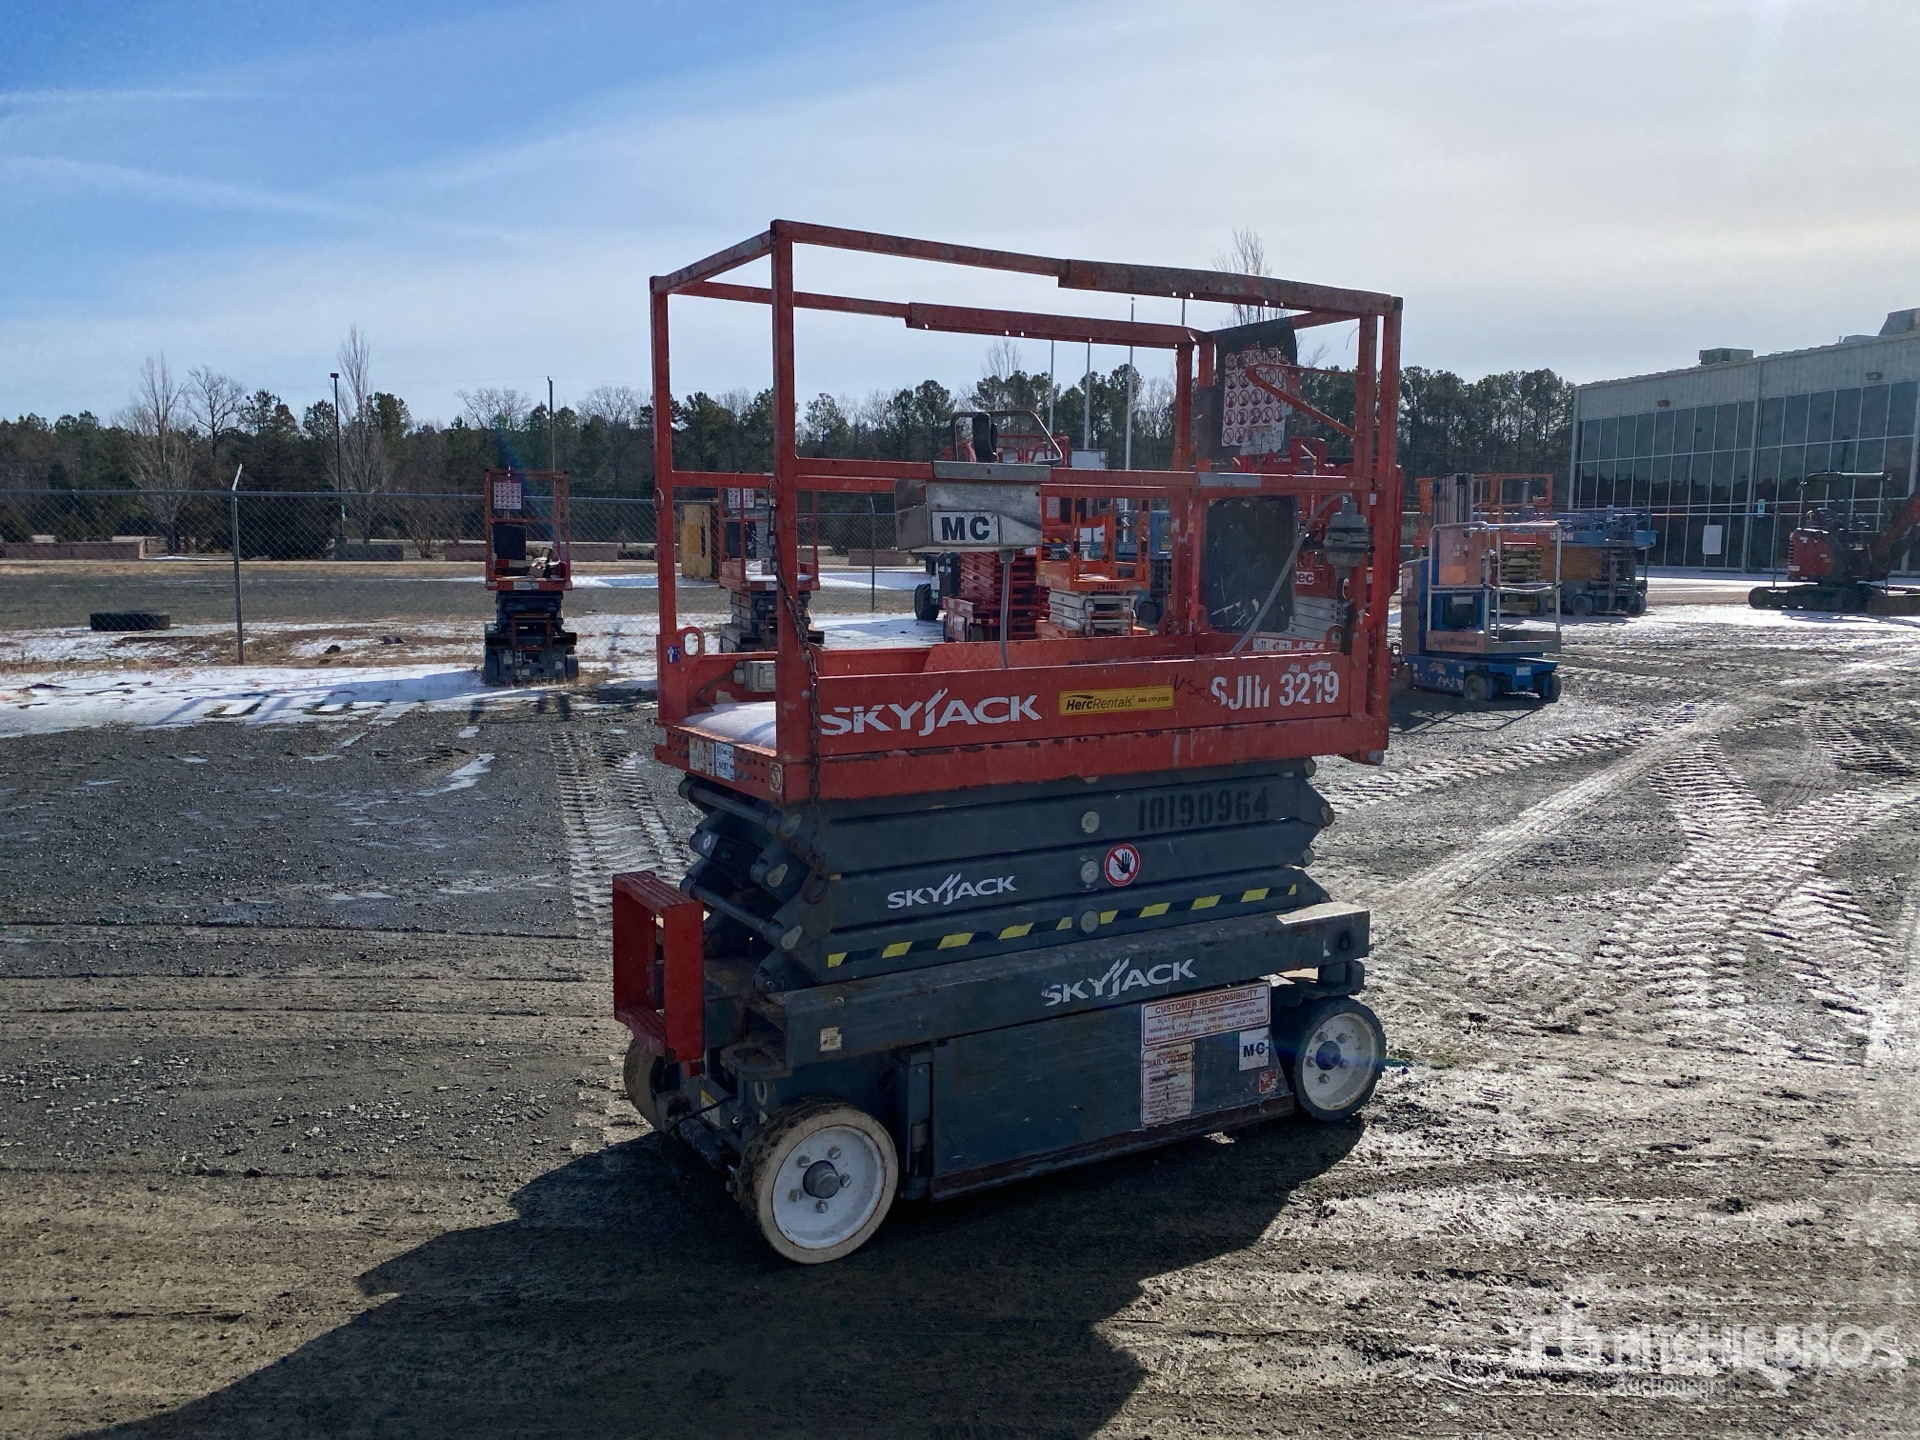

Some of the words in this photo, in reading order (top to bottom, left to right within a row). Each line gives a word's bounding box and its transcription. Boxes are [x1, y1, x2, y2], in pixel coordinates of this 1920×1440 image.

[941, 516, 990, 541] MC
[1294, 573, 1314, 584] ec
[1279, 671, 1340, 707] 3219
[820, 688, 1043, 737] SKYJACK
[1066, 696, 1133, 711] HercRentals
[1138, 786, 1269, 832] 10190964
[887, 872, 1018, 910] SKYJACK
[1041, 957, 1198, 1007] SKYJACK
[1156, 1000, 1197, 1014] CUSTOMER
[1200, 989, 1258, 1006] RESPONSIBILITY
[1228, 1002, 1256, 1010] LUBRICATION
[1218, 1013, 1236, 1021] DAMAGE
[1243, 1042, 1266, 1057] MC
